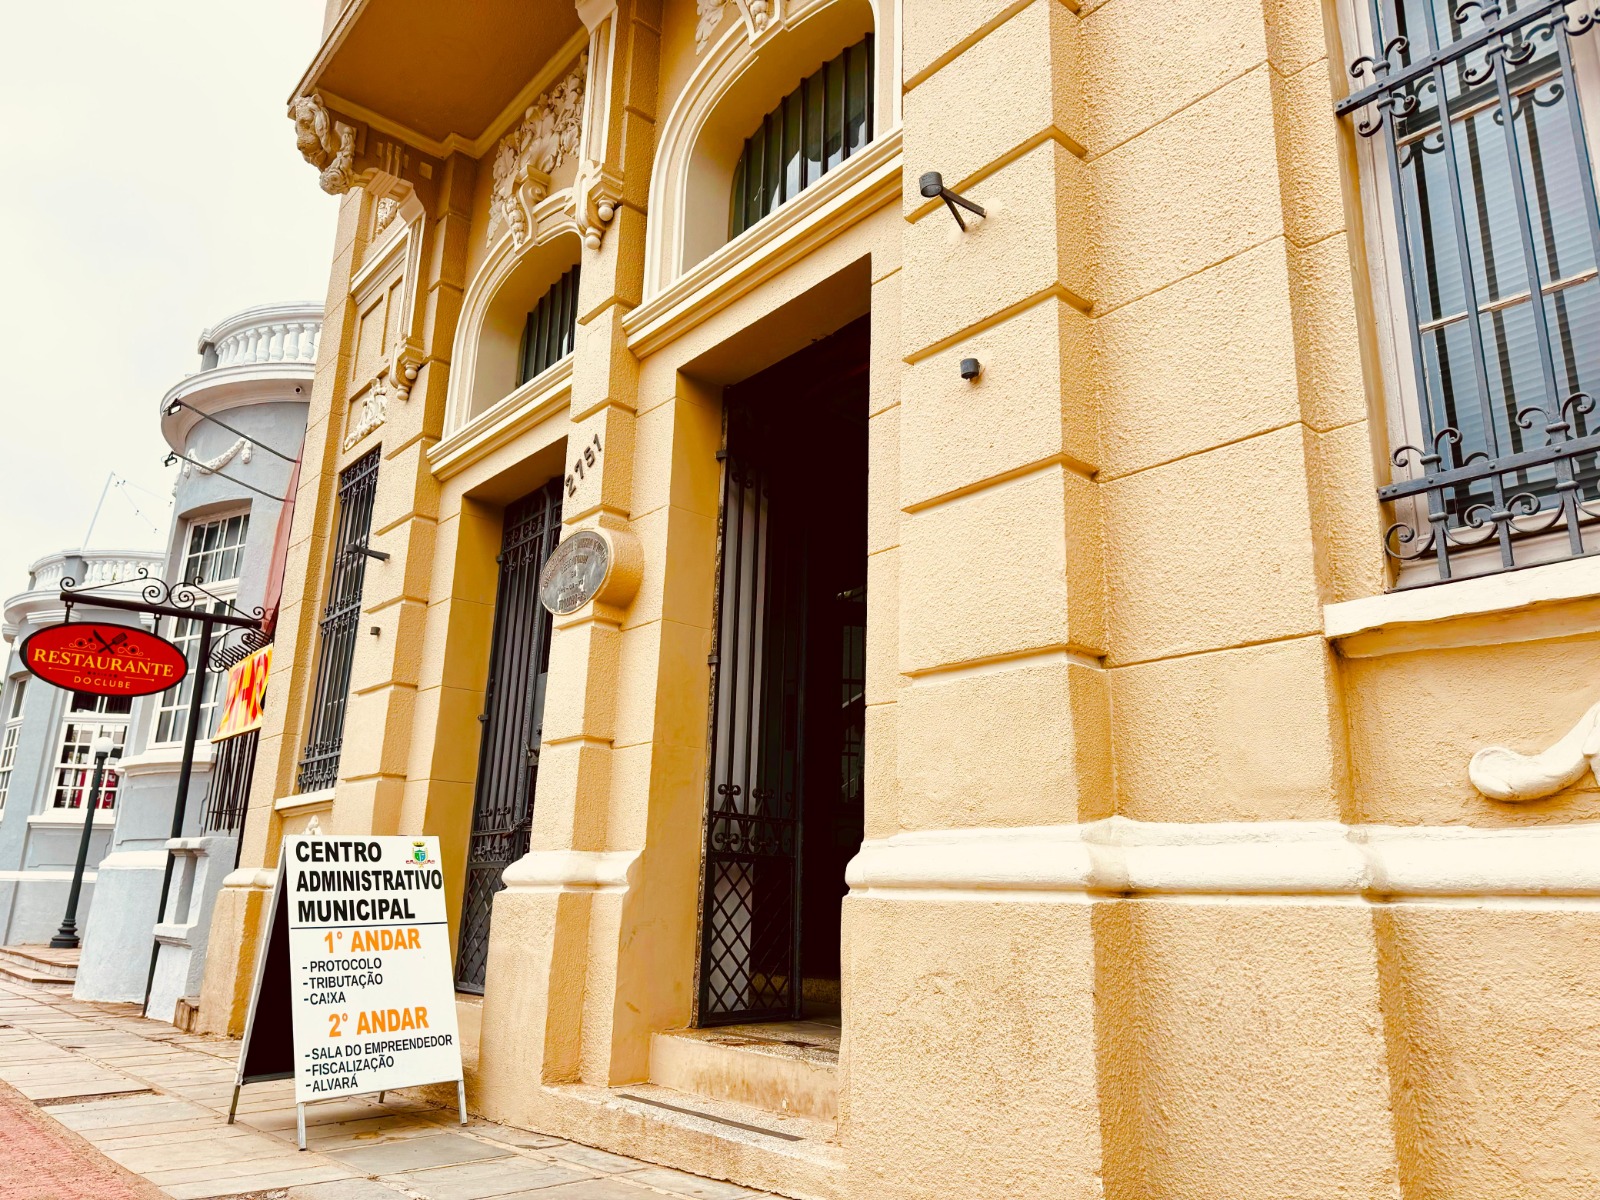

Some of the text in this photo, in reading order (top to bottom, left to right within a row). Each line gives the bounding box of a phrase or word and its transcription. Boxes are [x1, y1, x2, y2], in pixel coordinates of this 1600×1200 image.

[565, 434, 602, 497] 2751
[33, 648, 174, 677] RESTAURANTE
[295, 841, 381, 862] CENTRO
[296, 870, 442, 892] ADMINISTRATIVO
[298, 898, 415, 922] MUNICIPAL
[351, 928, 421, 952] ANDAR
[356, 1006, 428, 1035] ANDAR
[345, 1044, 362, 1057] DO
[365, 1034, 452, 1054] EMPREENDEDOR
